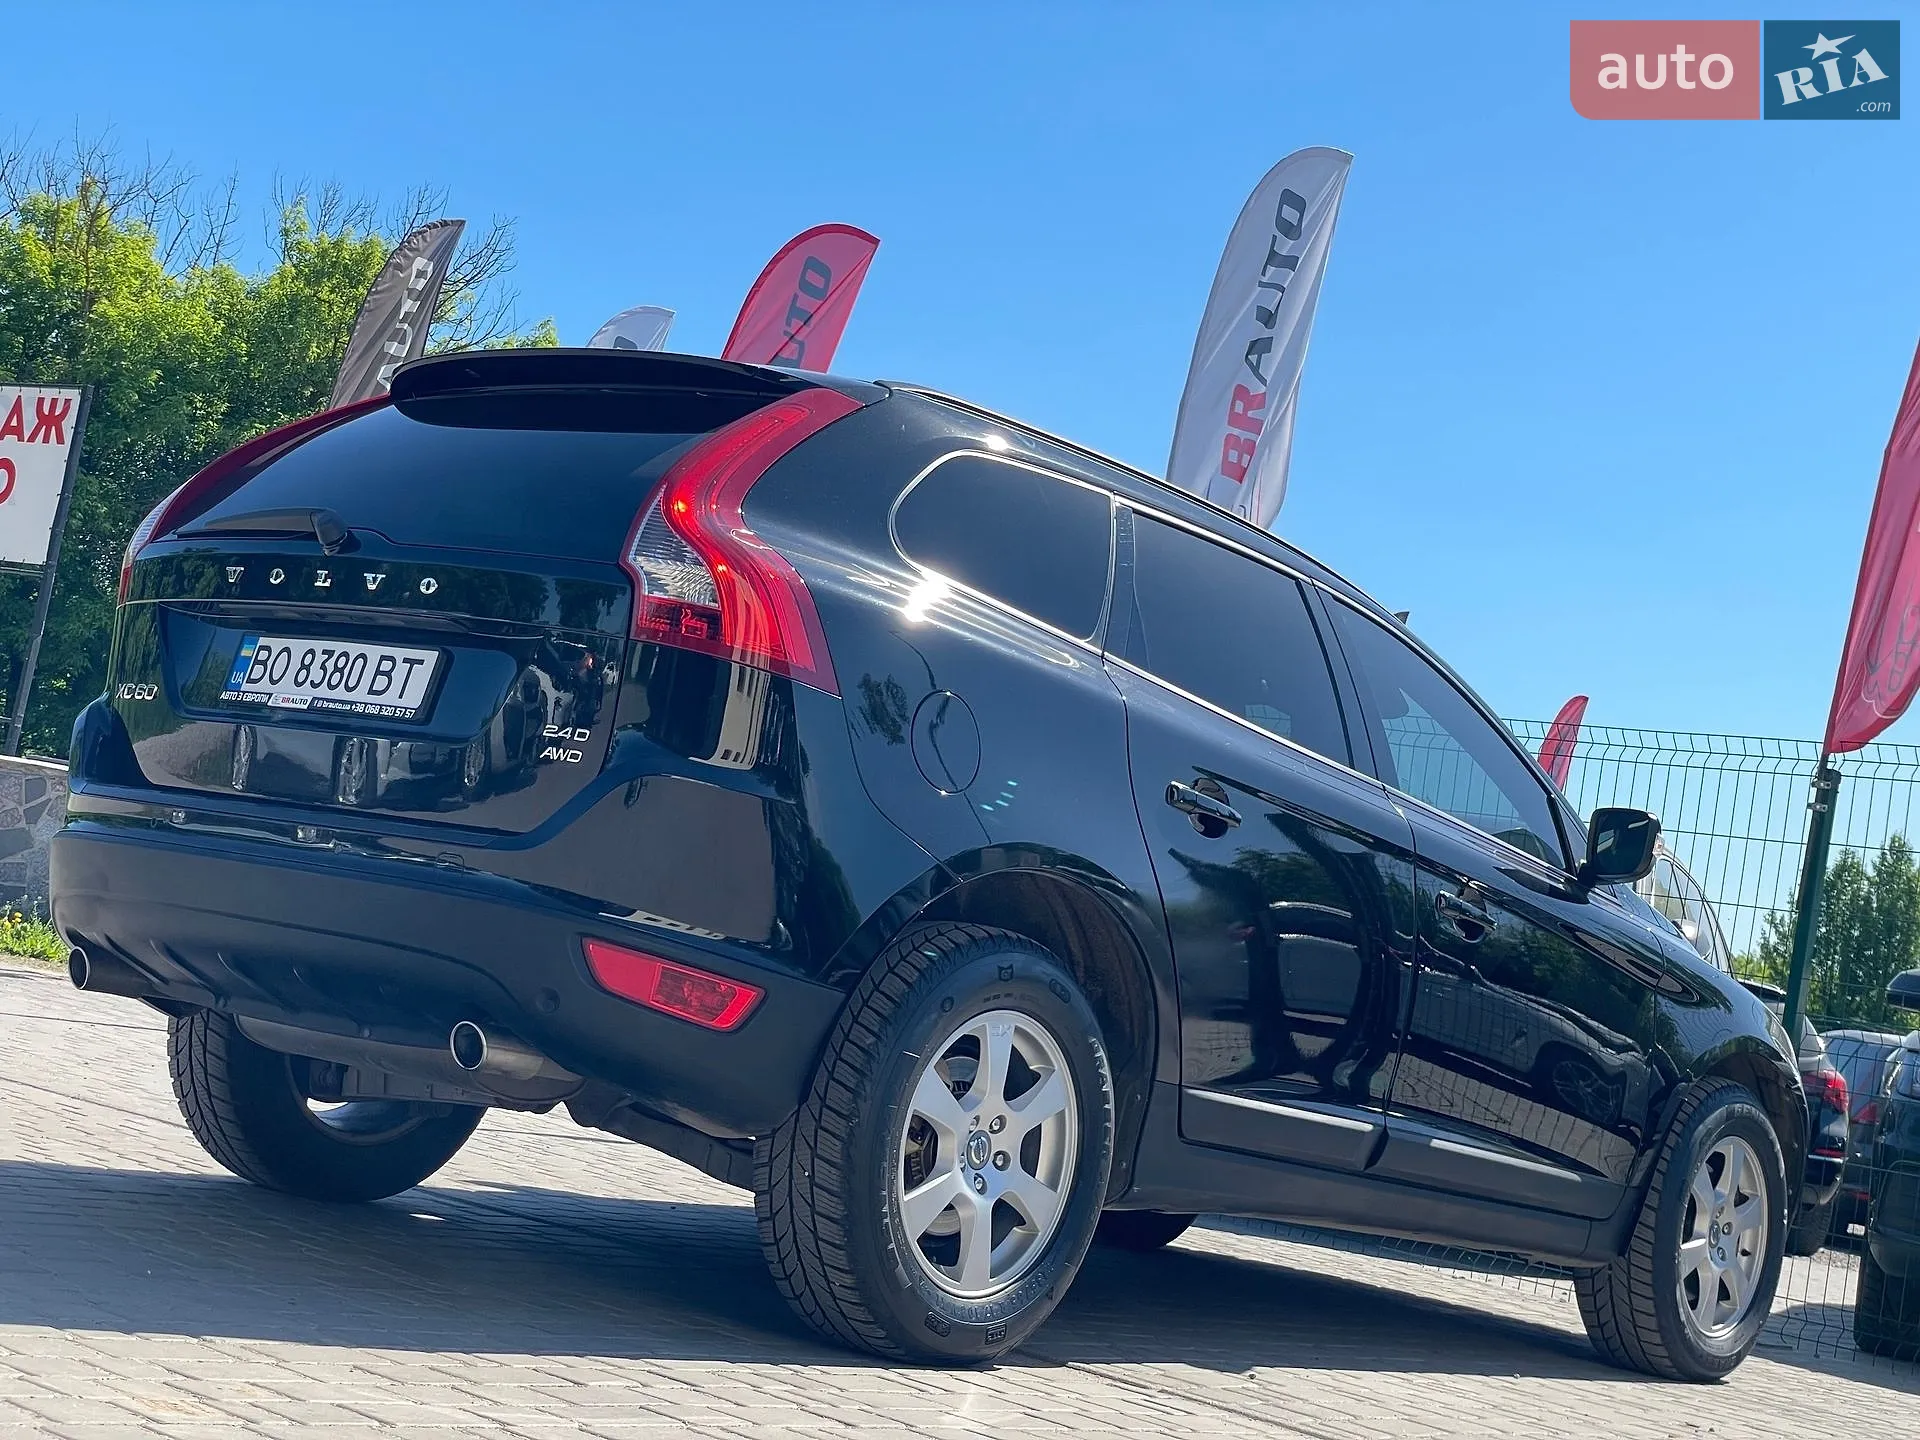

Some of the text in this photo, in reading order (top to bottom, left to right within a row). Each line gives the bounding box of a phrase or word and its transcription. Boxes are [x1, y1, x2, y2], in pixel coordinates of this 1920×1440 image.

[1220, 188, 1308, 485] BRAUTO
[226, 566, 438, 595] VOLVO
[231, 671, 244, 684] UA
[293, 648, 368, 693] 8380
[116, 683, 158, 700] XC60
[281, 697, 308, 705] BRAUTO
[322, 700, 351, 710] brauto.ua
[351, 703, 364, 713] +38
[365, 704, 380, 714] 068
[380, 706, 394, 716] 320
[394, 708, 405, 717] 57
[404, 709, 416, 718] 57
[540, 747, 582, 763] AWD
